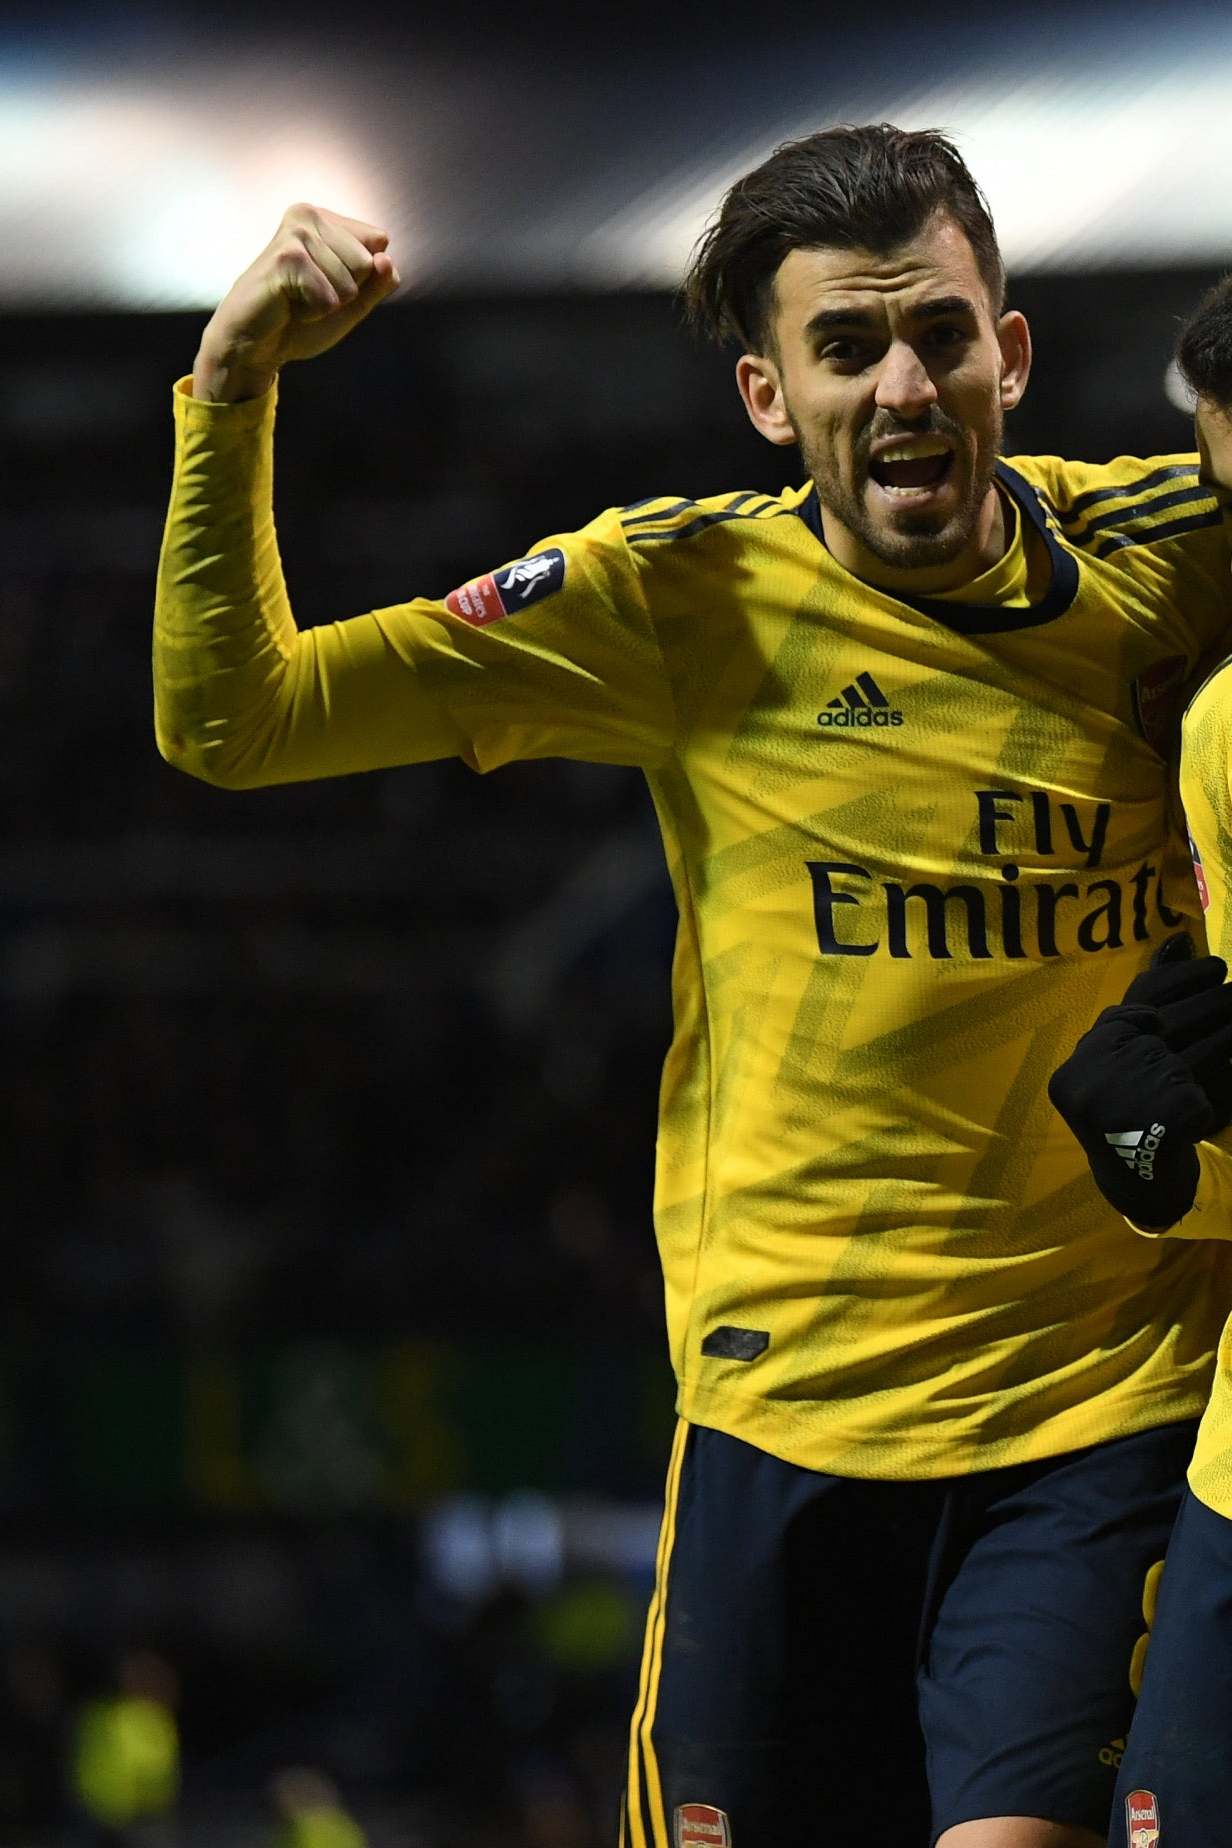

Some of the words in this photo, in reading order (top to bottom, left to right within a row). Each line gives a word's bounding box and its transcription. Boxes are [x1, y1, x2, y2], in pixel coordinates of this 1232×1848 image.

[817, 707, 904, 728] adidas
[974, 790, 1111, 868] Fly
[1137, 1122, 1166, 1181] adidas
